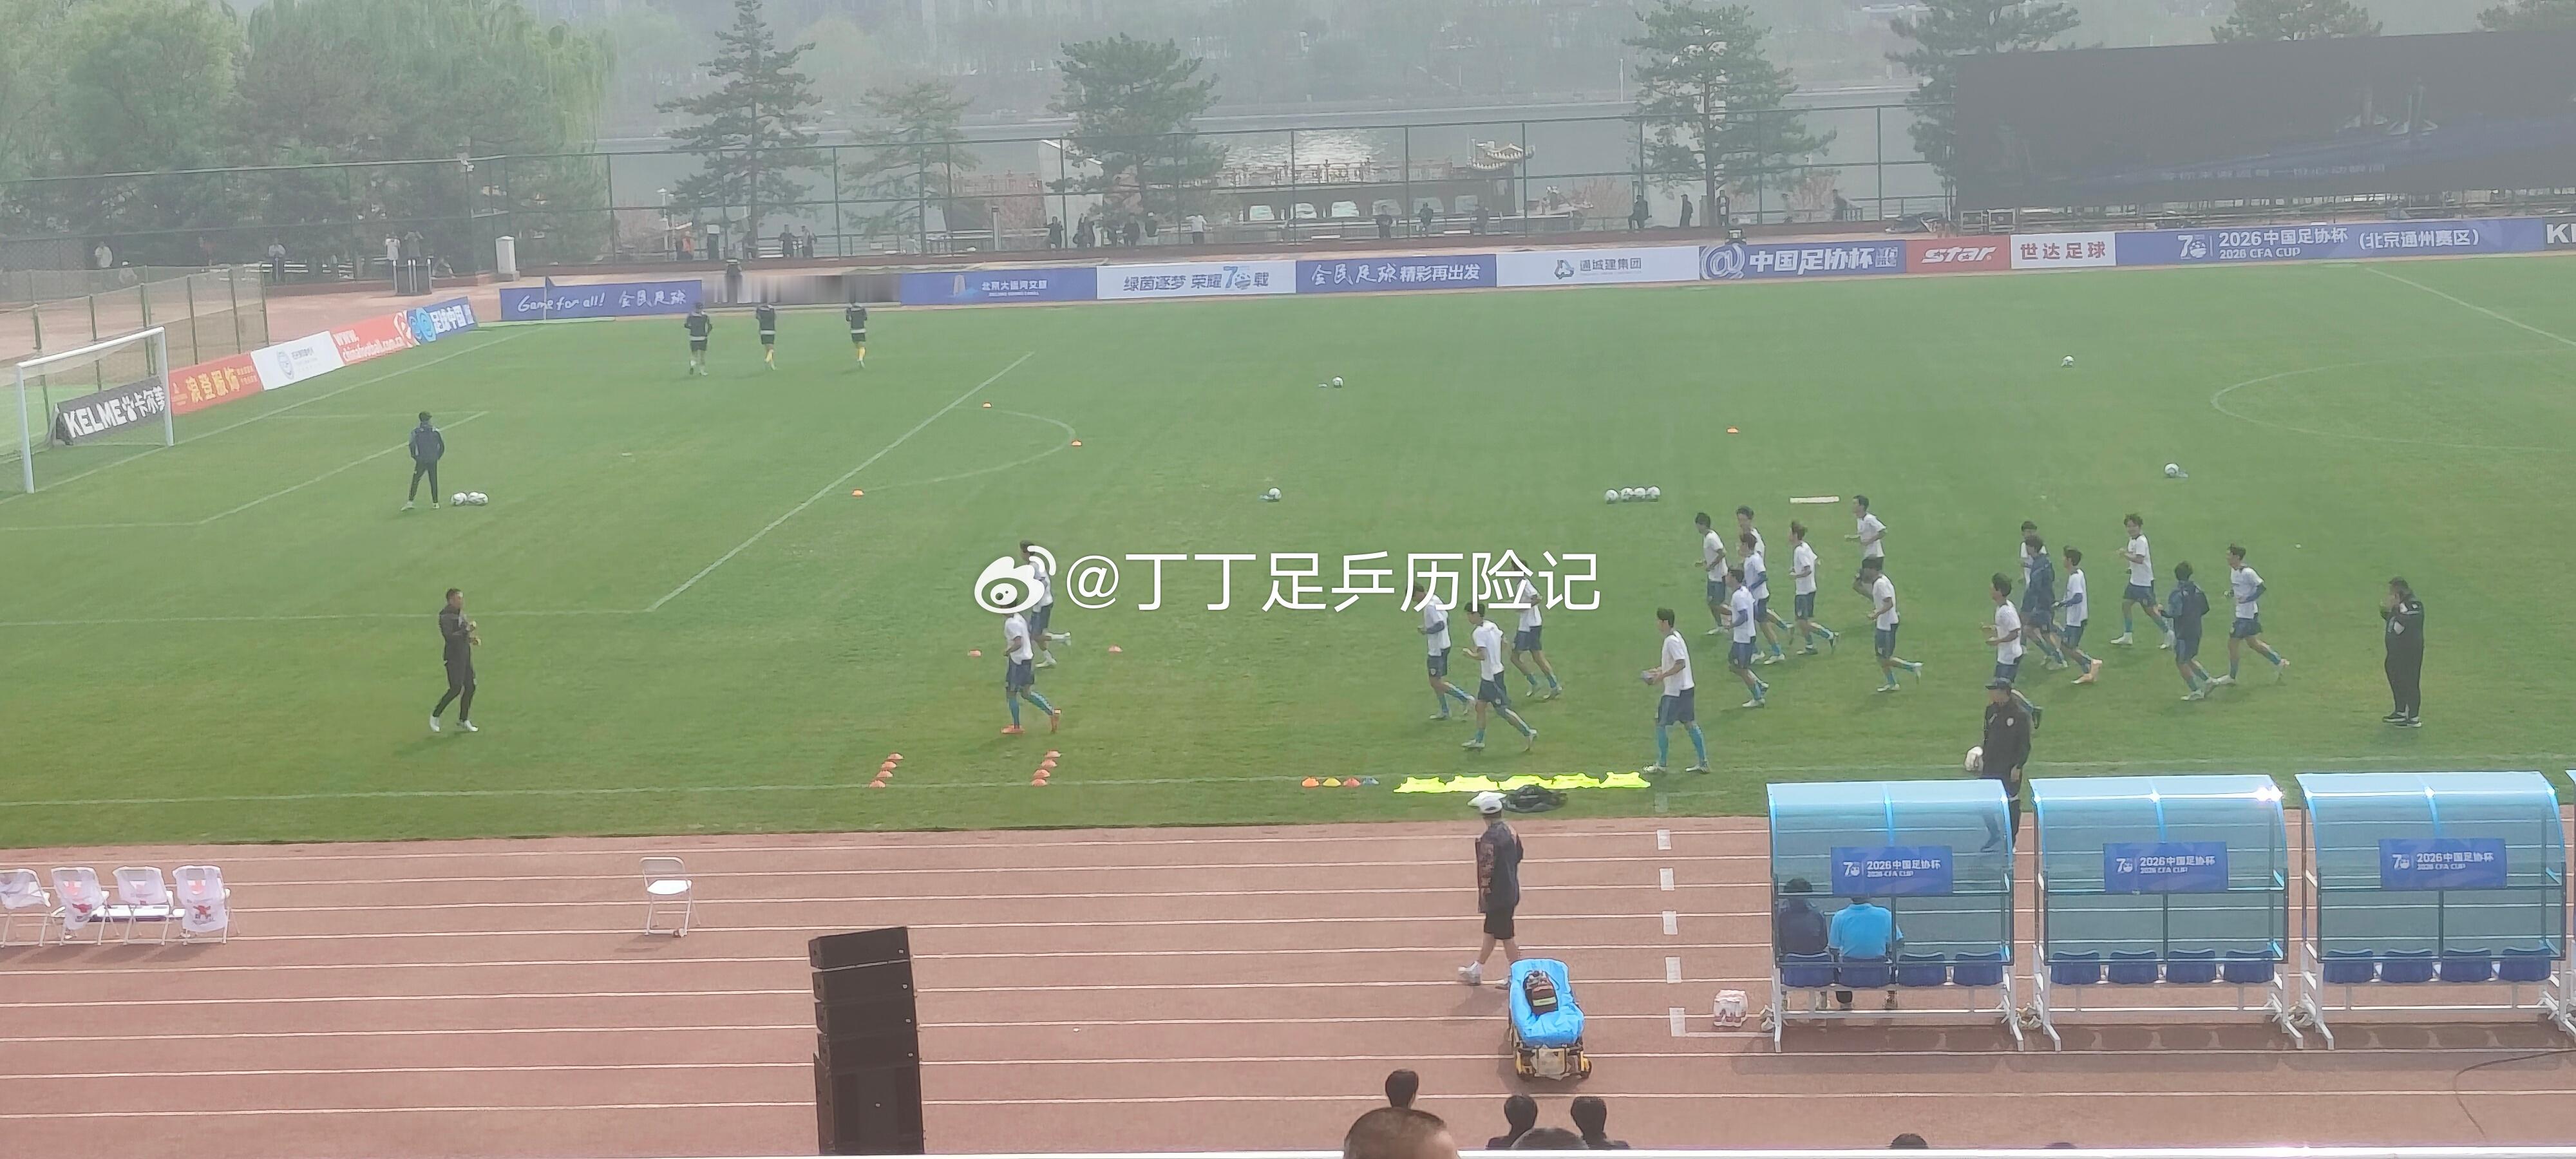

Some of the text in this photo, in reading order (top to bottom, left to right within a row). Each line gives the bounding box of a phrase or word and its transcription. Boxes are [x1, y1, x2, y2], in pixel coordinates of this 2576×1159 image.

[2020, 241, 2106, 260] 世达足球
[2249, 248, 2273, 258] CFA
[2276, 247, 2301, 257] CUP
[1123, 275, 1186, 291] 绿茵逐梦
[518, 295, 553, 312] Game
[556, 296, 580, 311] for
[583, 292, 605, 308] all!
[63, 399, 128, 438] KELME
